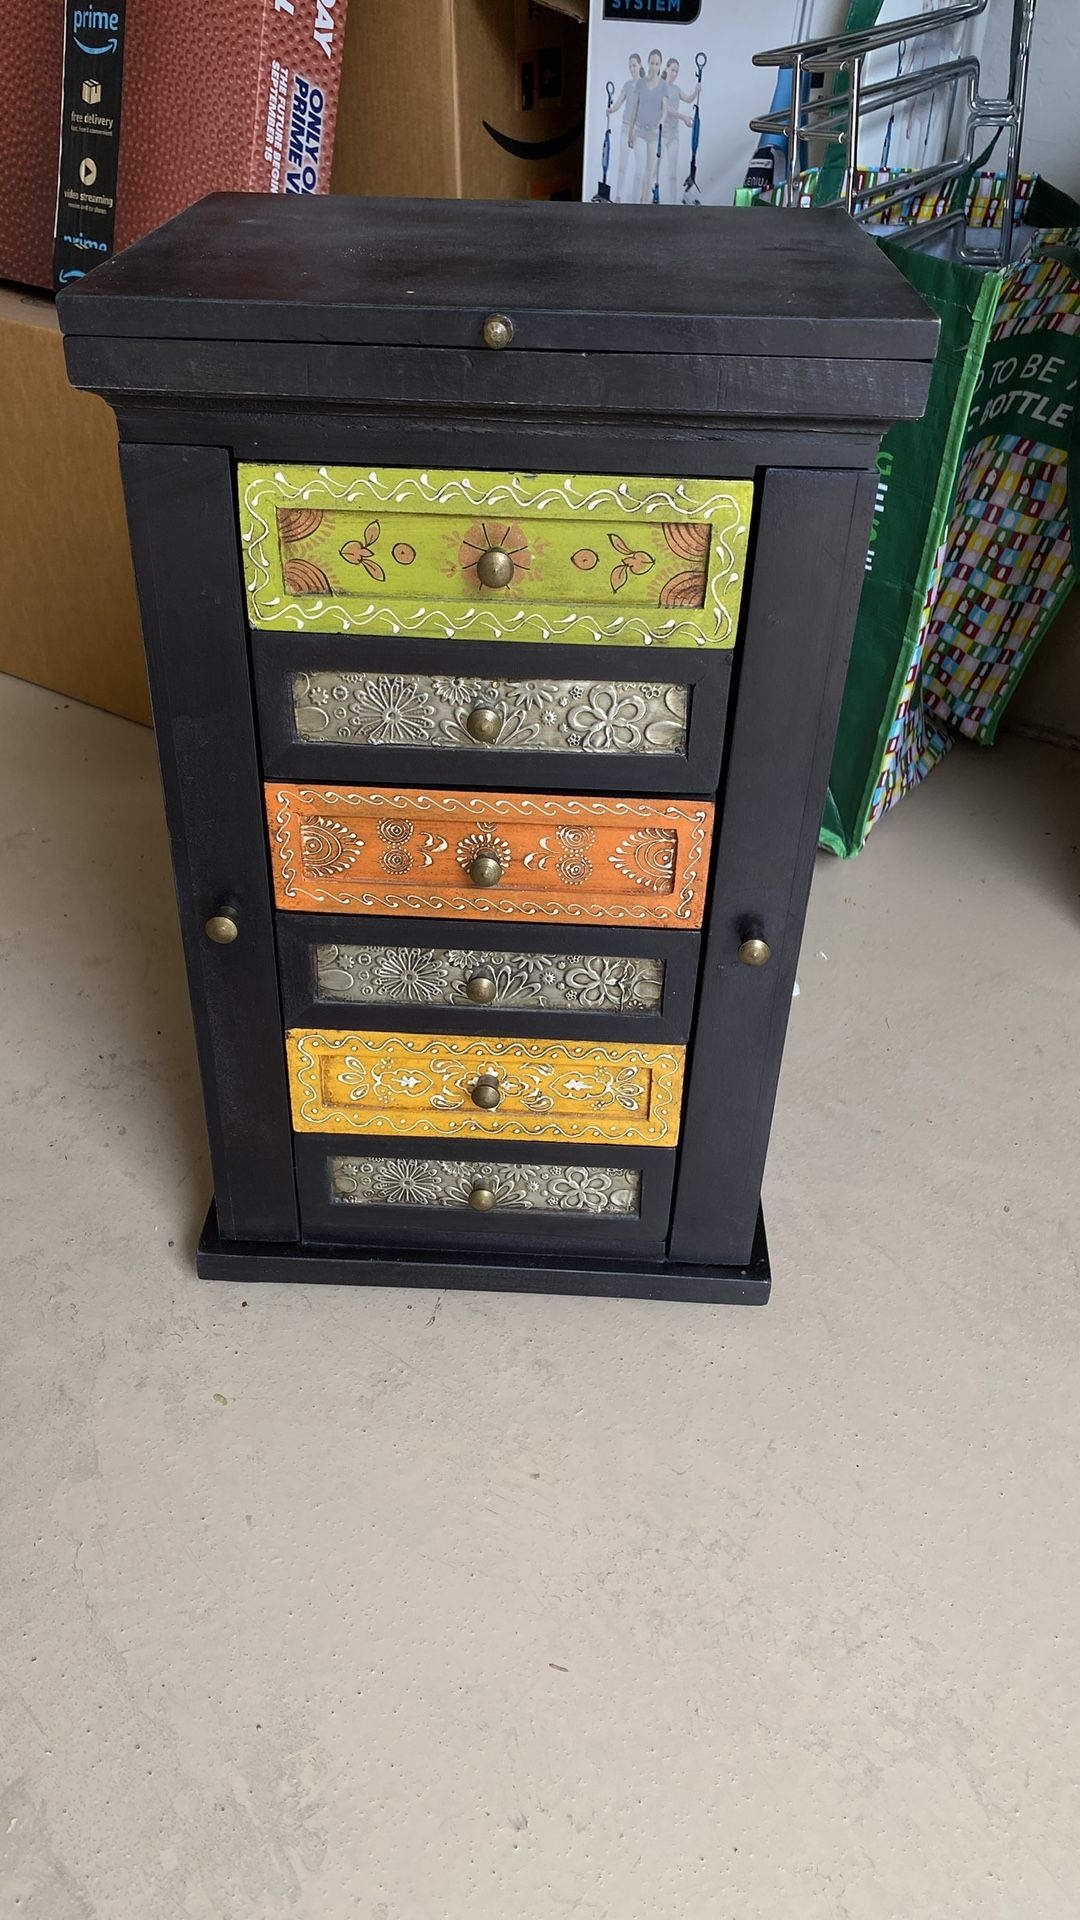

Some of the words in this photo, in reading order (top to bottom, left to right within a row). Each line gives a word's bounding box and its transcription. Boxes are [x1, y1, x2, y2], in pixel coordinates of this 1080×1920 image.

[73, 4, 119, 33] prime
[278, 67, 289, 96] THE
[71, 110, 83, 123] free
[84, 112, 114, 130] delivery
[265, 59, 281, 145] SEPTEMBER
[273, 95, 287, 153] FUTURE
[288, 76, 309, 167] PRIME
[305, 88, 324, 164] ONLY
[263, 144, 273, 162] 15
[63, 189, 79, 200] video
[80, 192, 114, 209] streaming
[988, 356, 1018, 390] TO
[1019, 353, 1066, 384] BE
[979, 390, 1074, 428] BOTTLE
